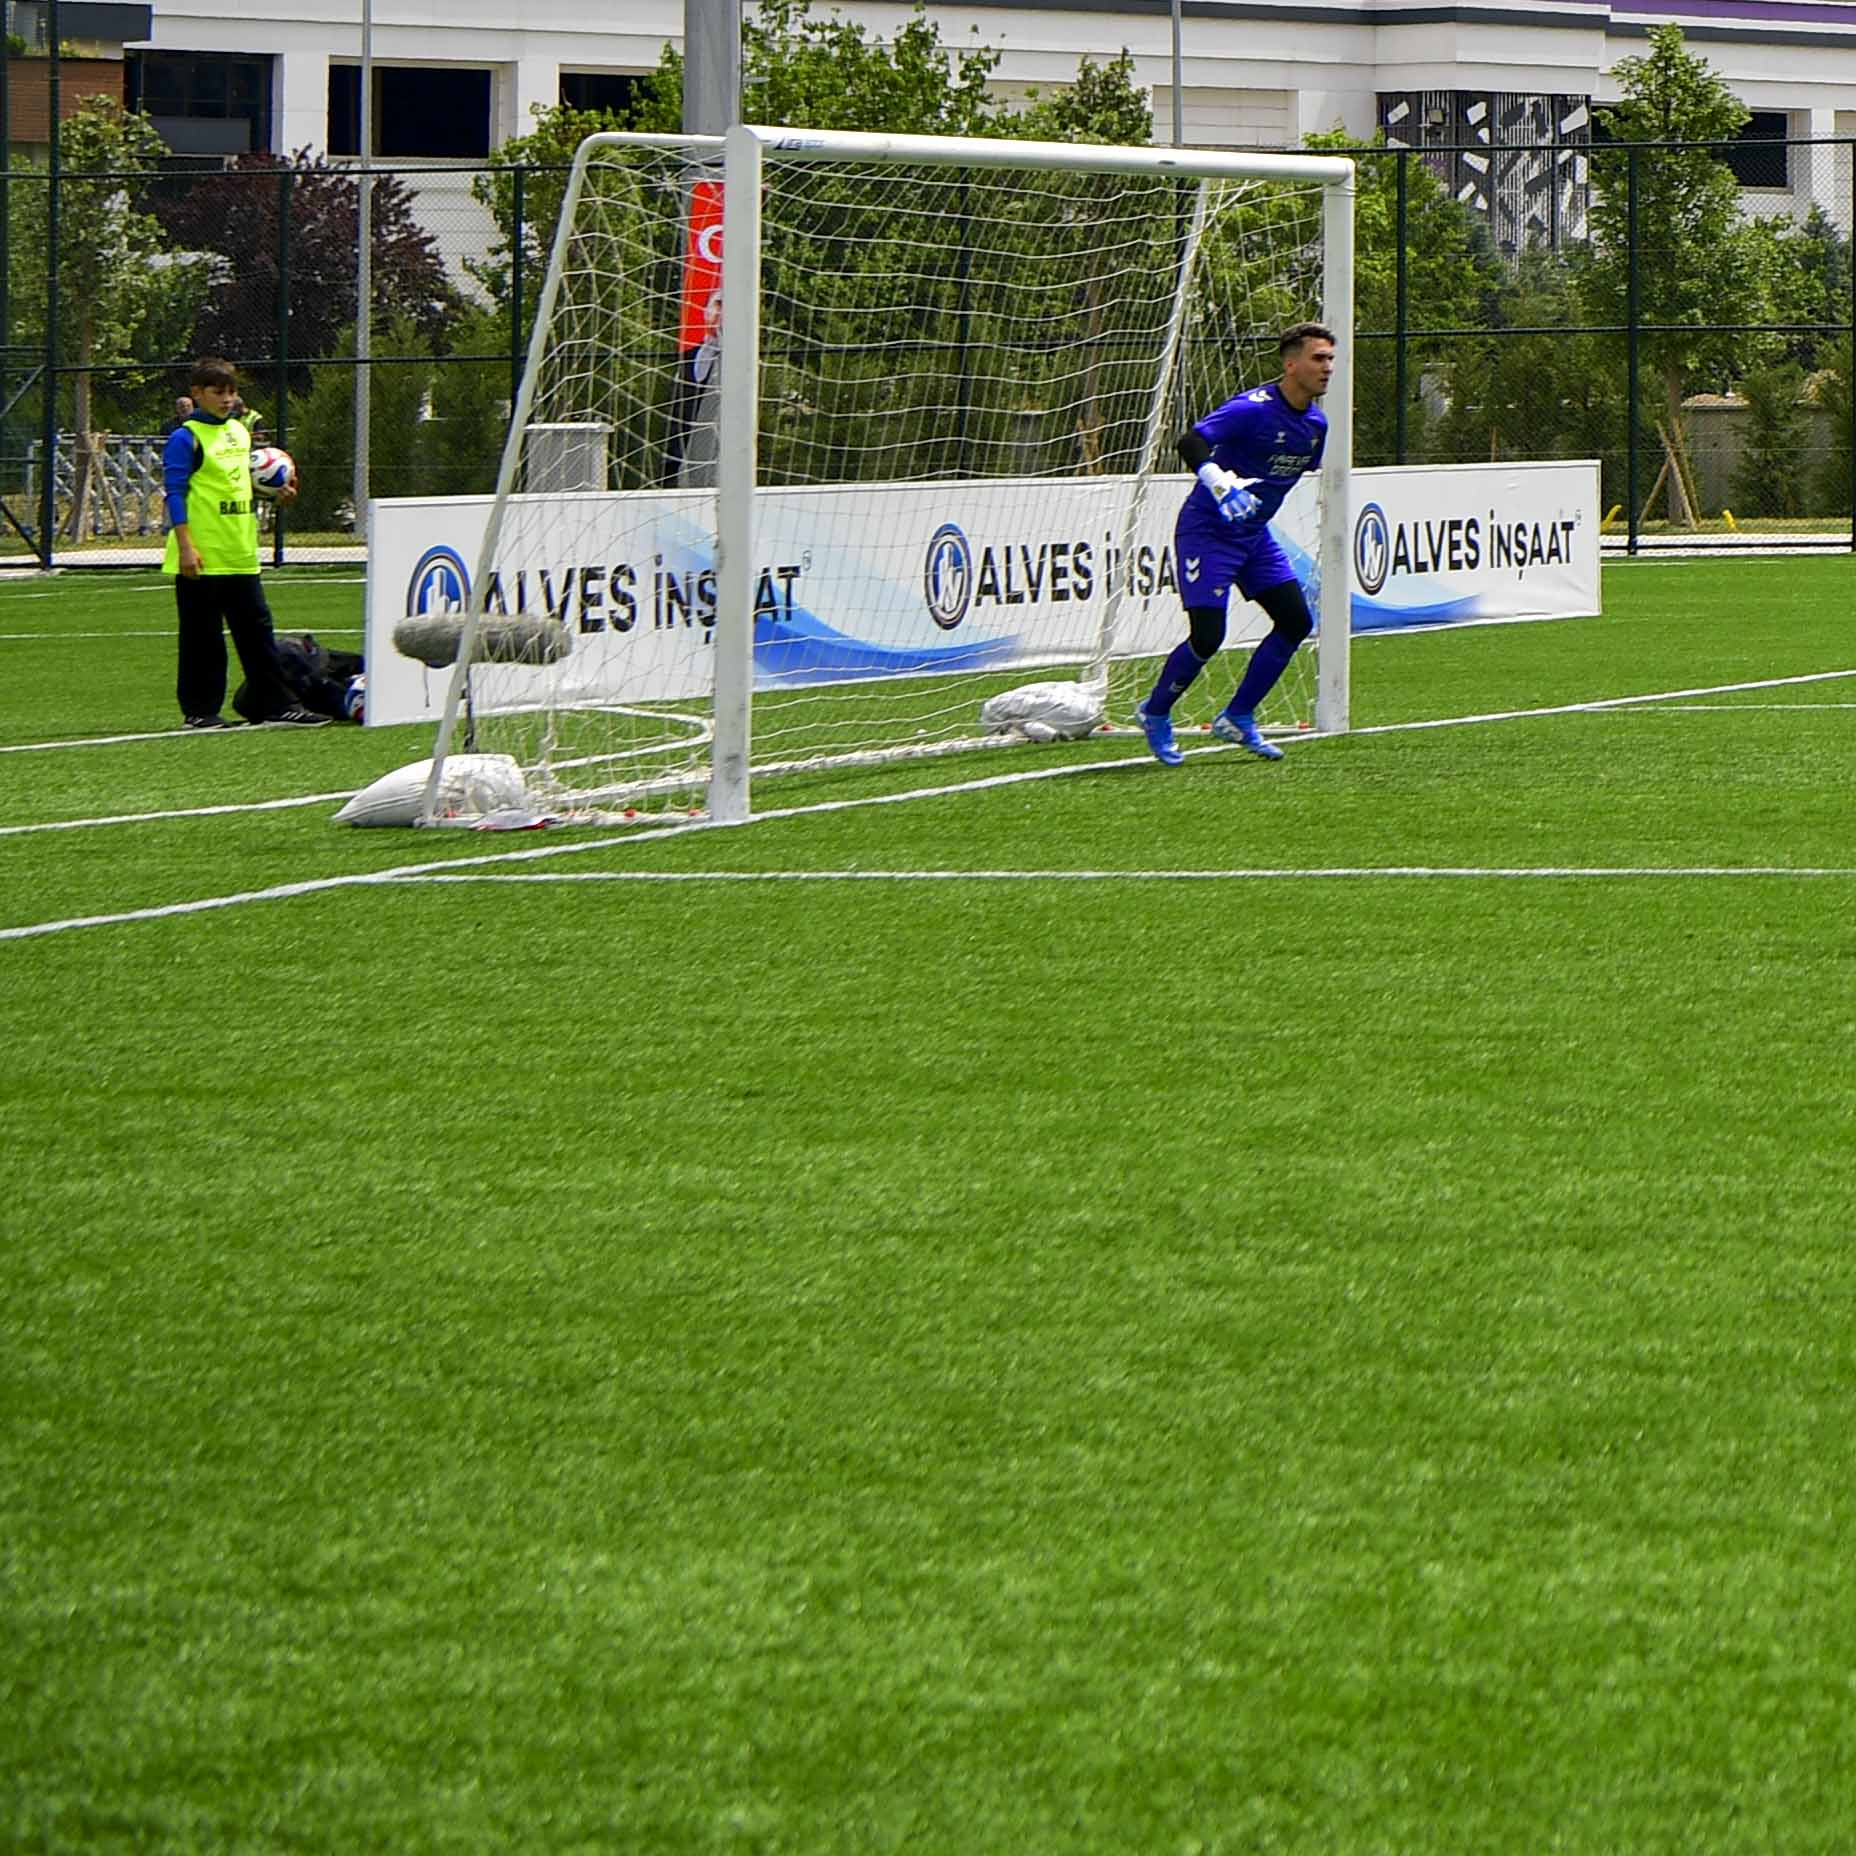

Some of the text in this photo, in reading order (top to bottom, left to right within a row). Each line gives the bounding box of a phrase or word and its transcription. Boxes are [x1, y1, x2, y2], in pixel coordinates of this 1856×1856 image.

[974, 541, 1094, 607] ALVES
[1391, 508, 1576, 581] ALVES İNŞAAT
[654, 553, 801, 645] İNŞAT
